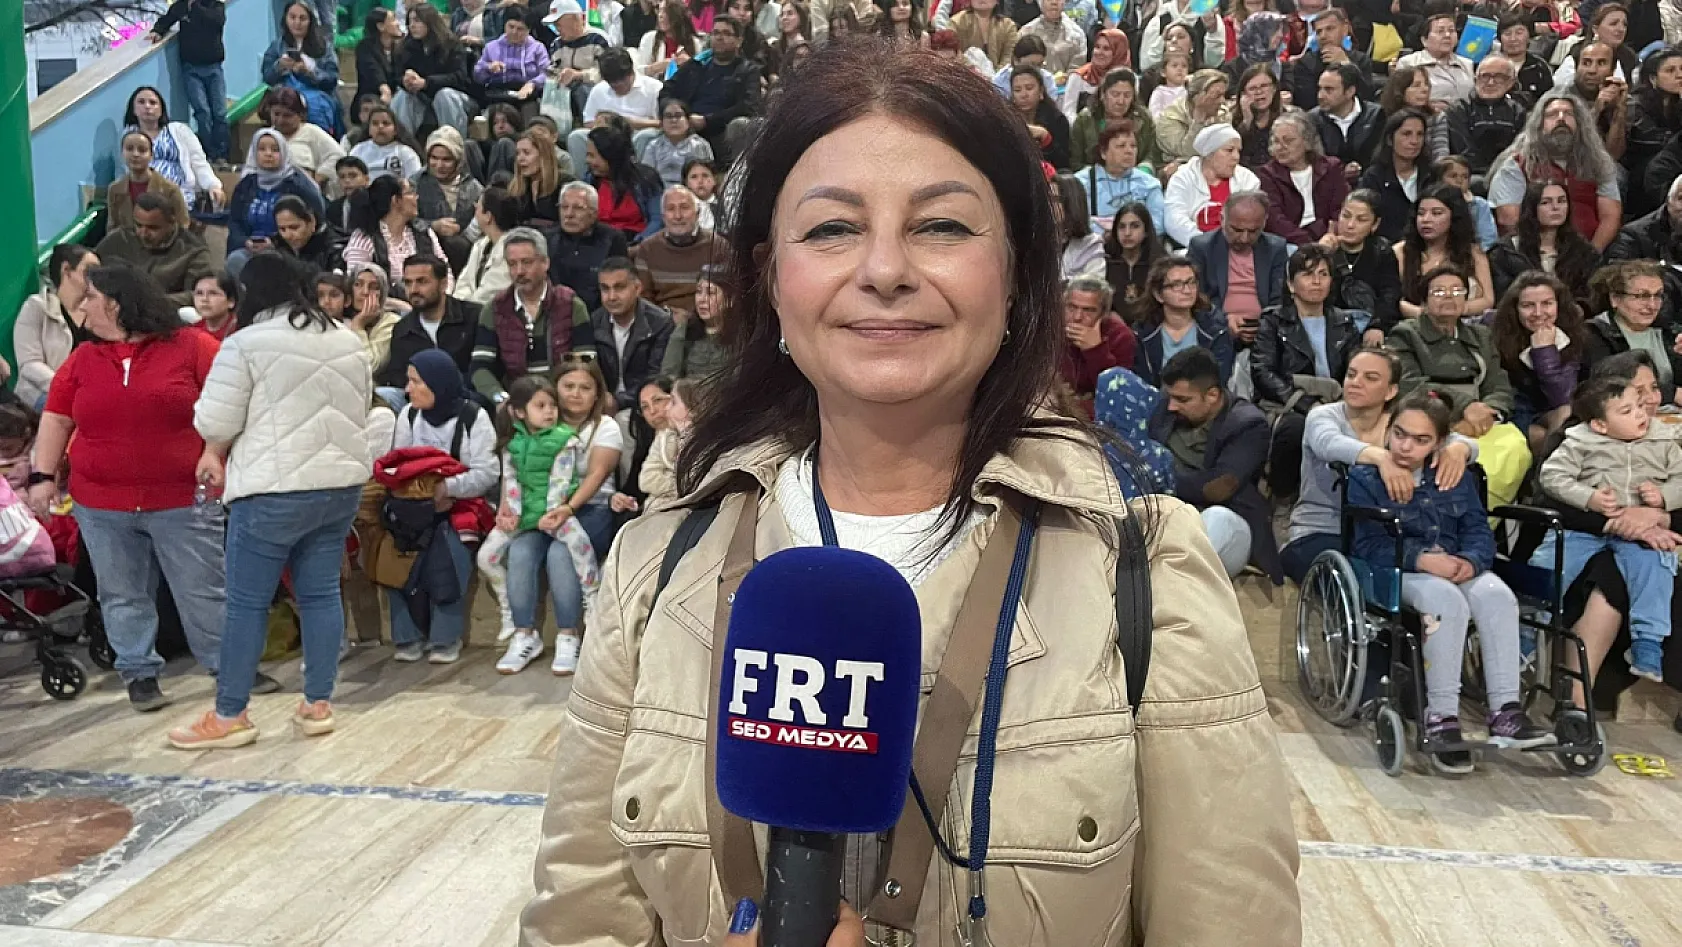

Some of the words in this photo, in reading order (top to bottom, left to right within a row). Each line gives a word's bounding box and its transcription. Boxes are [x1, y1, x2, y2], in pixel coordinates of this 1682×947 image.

[728, 648, 885, 729] FRT
[731, 720, 772, 739] SED
[777, 727, 869, 750] MEDYA
